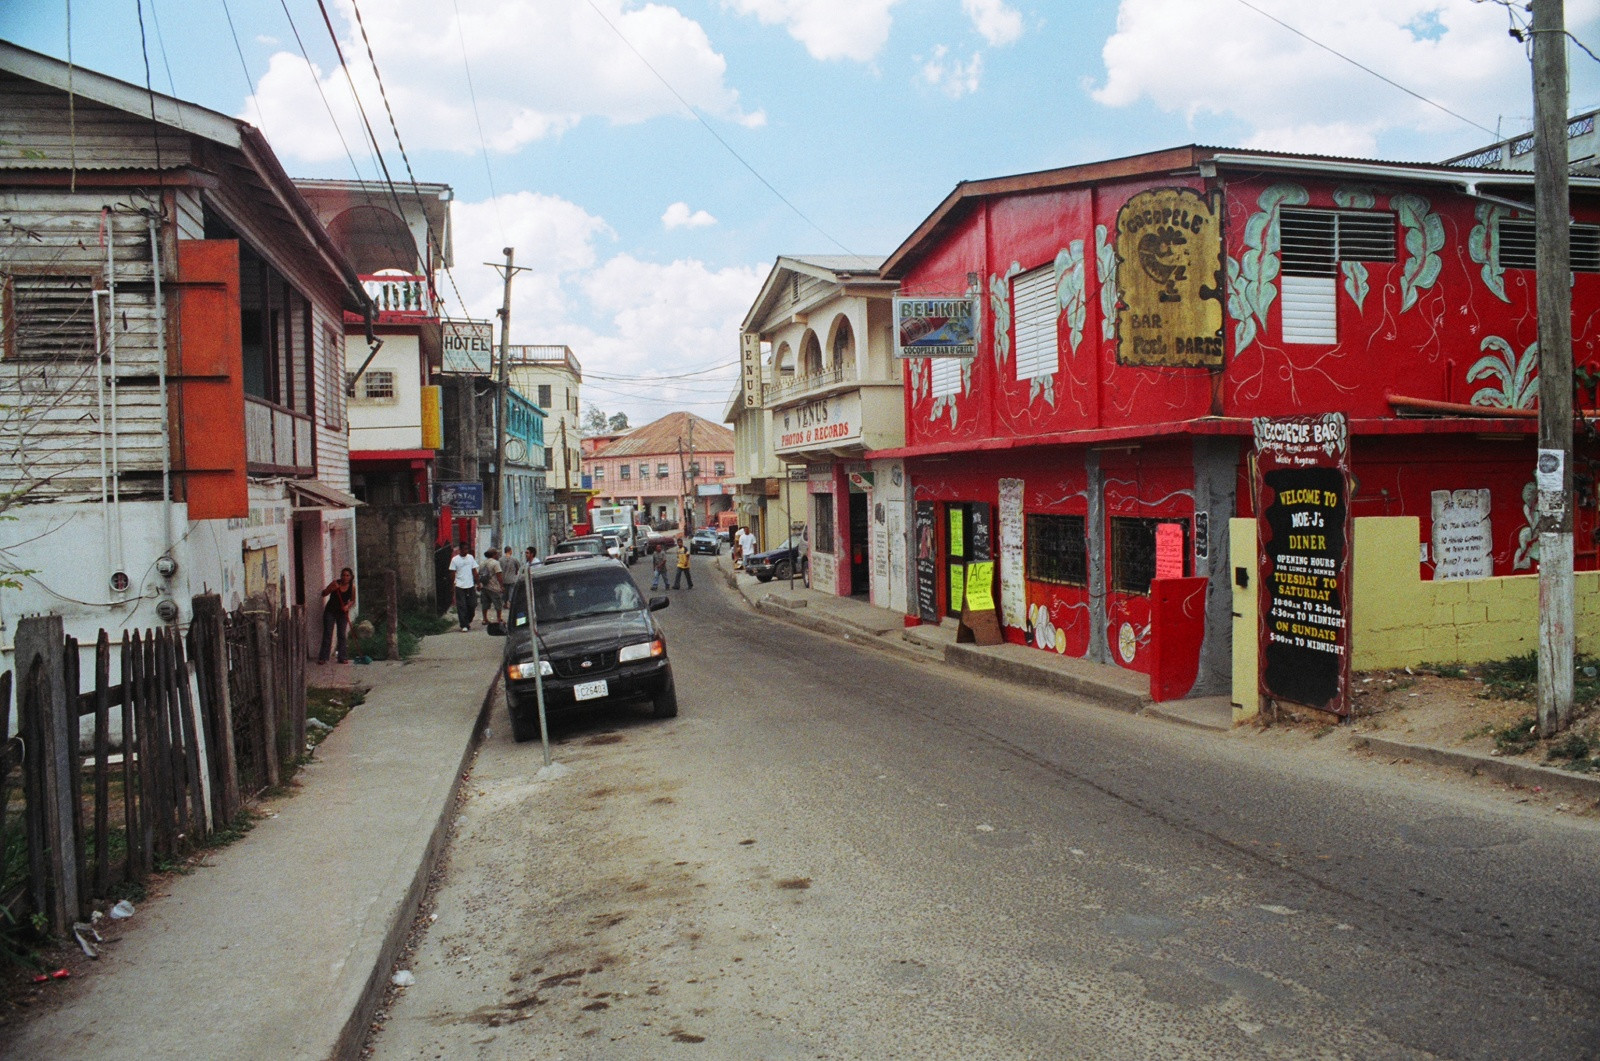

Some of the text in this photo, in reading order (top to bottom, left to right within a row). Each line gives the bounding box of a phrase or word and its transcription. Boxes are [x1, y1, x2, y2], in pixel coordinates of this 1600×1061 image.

[901, 301, 973, 318] BELIKIN
[1131, 314, 1162, 329] BAR
[444, 336, 490, 351] HOTEL
[956, 346, 973, 354] GRILL
[1175, 337, 1222, 356] DARTS
[744, 335, 755, 406] VENUS
[796, 400, 828, 428] VENUS
[781, 433, 804, 446] PHOTOS
[814, 422, 849, 440] RECORDS
[1314, 422, 1338, 442] BAR
[1280, 489, 1337, 507] WELCOME TO
[1289, 535, 1327, 550] DINER
[1276, 554, 1336, 569] OPENING HOURS
[1275, 572, 1337, 589] TUESDAY TO
[1313, 569, 1336, 577] DINNER
[1278, 584, 1331, 601] SATURDAY
[1303, 601, 1313, 611] TO
[1297, 611, 1307, 621] TO
[1308, 613, 1346, 629] MIDNIGHT
[1276, 620, 1336, 641] ON SUNDAYS
[1295, 636, 1305, 647] TO
[1306, 639, 1345, 656] MIDNIGHT
